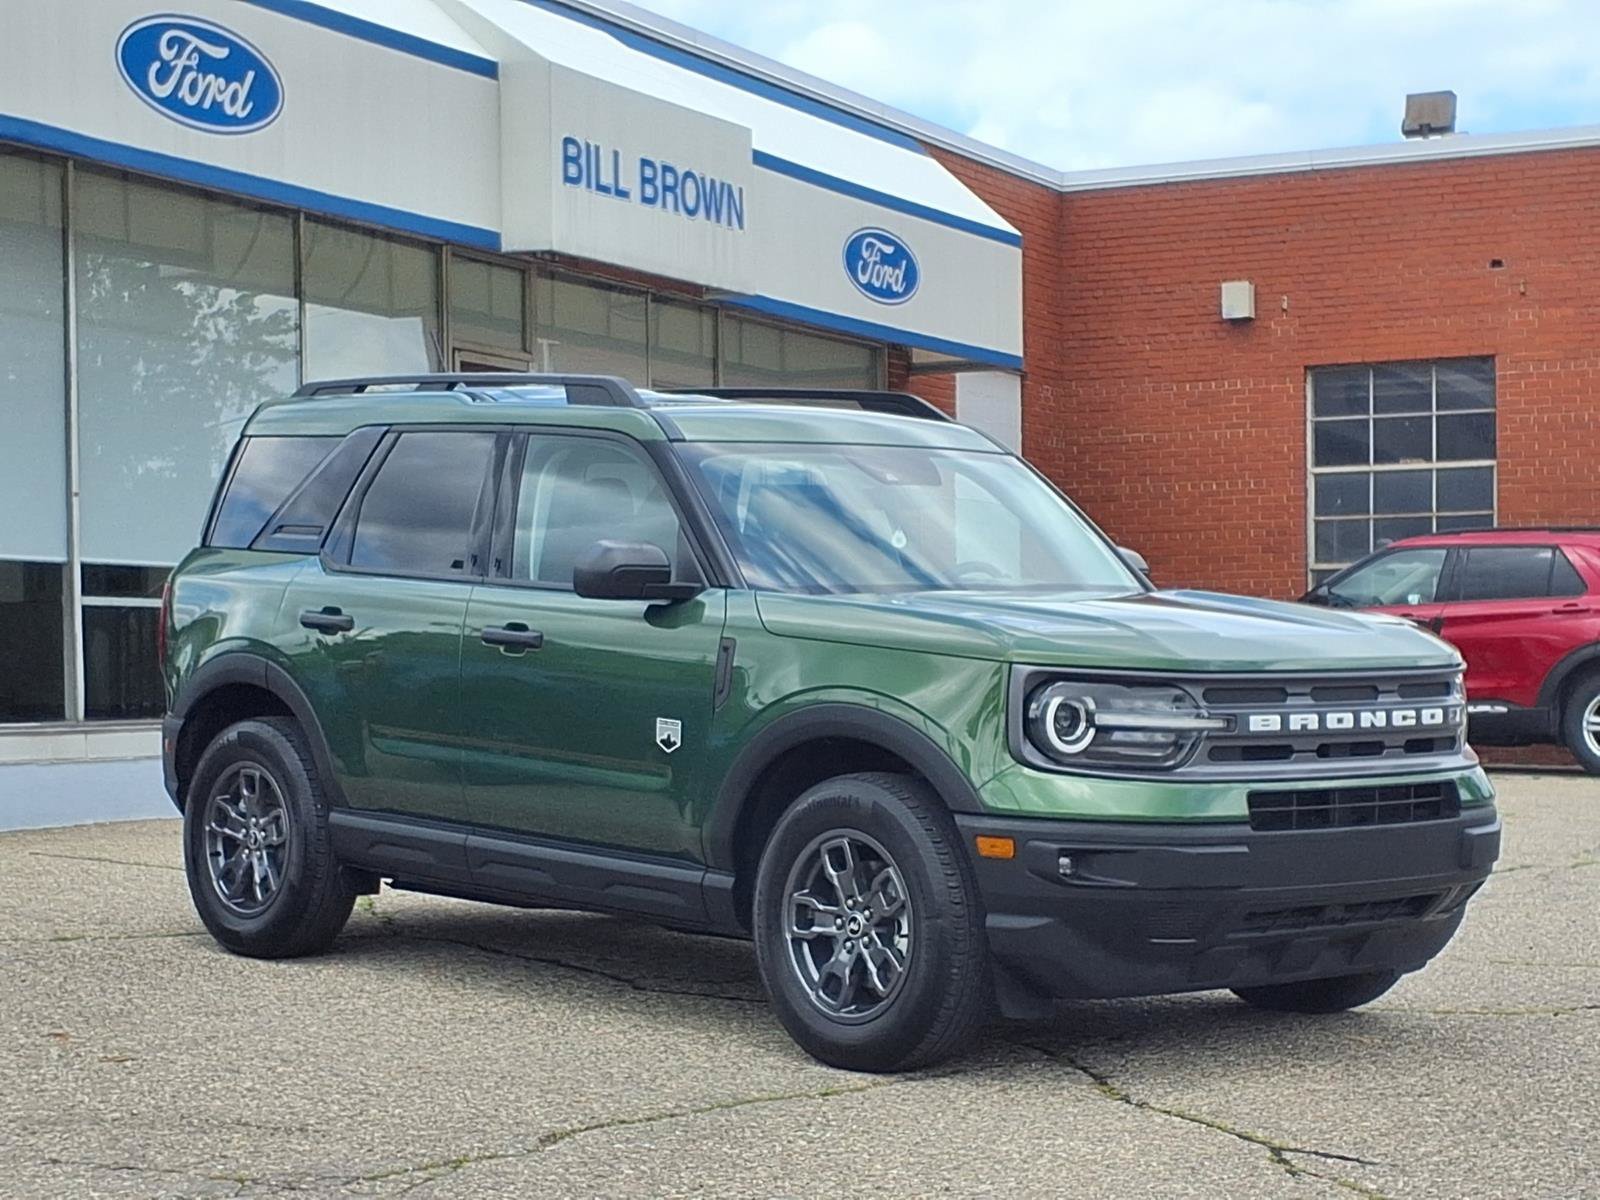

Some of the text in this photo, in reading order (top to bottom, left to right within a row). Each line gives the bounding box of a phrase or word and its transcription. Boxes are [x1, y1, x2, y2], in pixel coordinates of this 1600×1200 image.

[147, 29, 256, 119] Ford
[562, 136, 744, 230] BILL BROWN
[857, 237, 907, 294] Ford
[1249, 708, 1444, 732] BRONCO
